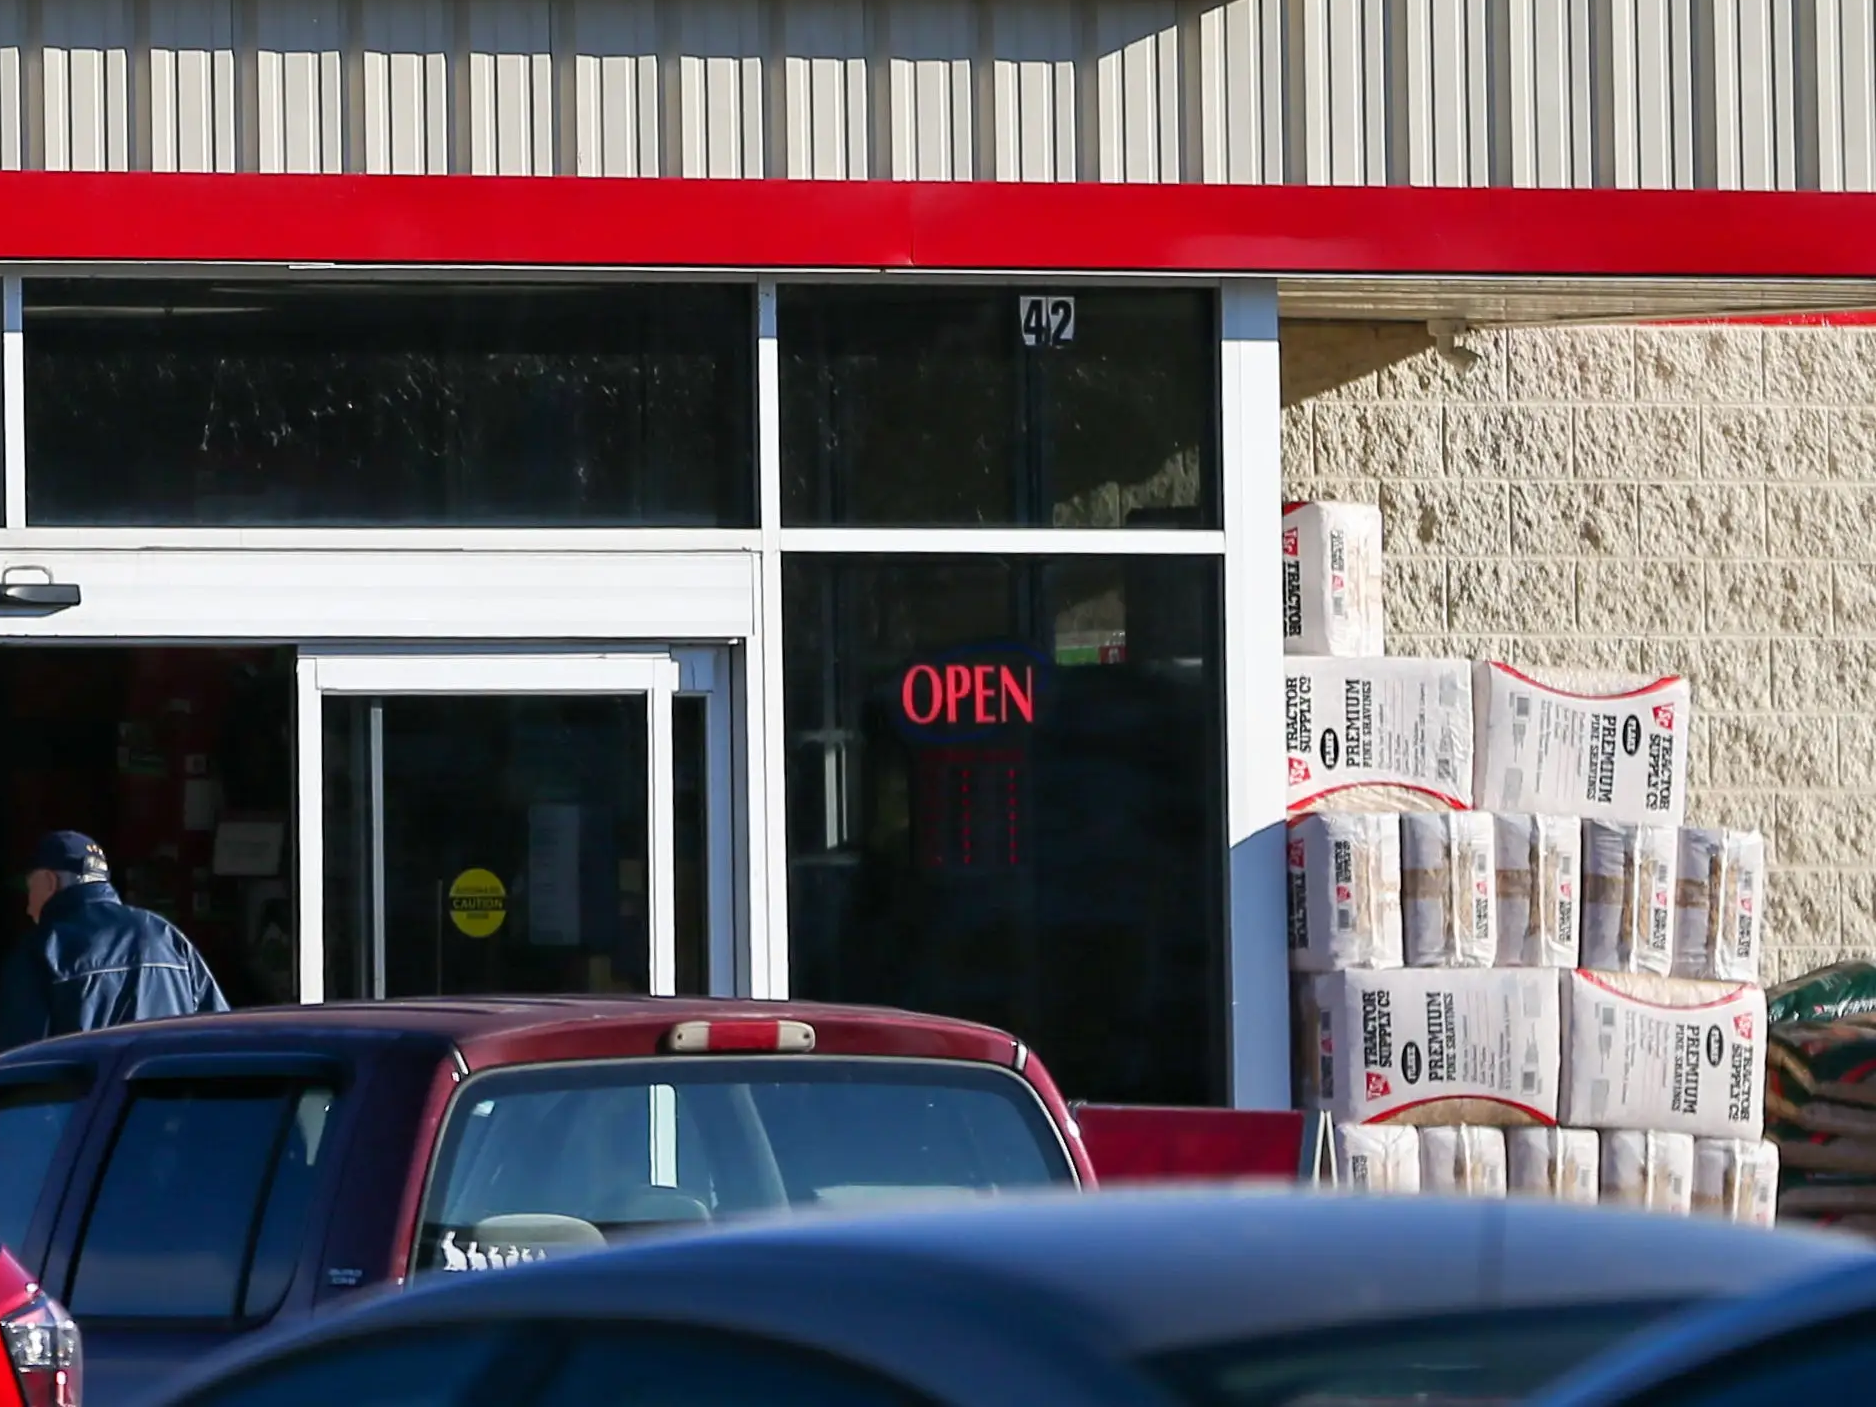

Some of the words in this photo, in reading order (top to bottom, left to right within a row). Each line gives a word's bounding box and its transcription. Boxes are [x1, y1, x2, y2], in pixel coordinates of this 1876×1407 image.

[1023, 298, 1073, 344] 42
[1287, 560, 1302, 637] TRACTOR
[902, 664, 1034, 724] OPEN
[1286, 676, 1298, 753] TRACTOR
[1362, 680, 1373, 736] SHAVINGS
[1299, 696, 1312, 753] SUPPLY
[1345, 678, 1361, 768] PREMIUM
[1591, 713, 1600, 742] PINE
[1363, 737, 1373, 768] PINE
[1587, 745, 1599, 800] SHAVINGS
[1598, 714, 1617, 804] PREMIUM
[1647, 734, 1661, 790] SUPPLY
[1659, 735, 1673, 811] TRACTOR
[453, 897, 503, 910] CAUTION
[1363, 990, 1377, 1067] TRACTOR
[1378, 1010, 1392, 1067] SUPPLY
[1426, 991, 1444, 1082] PREMIUM
[1444, 992, 1456, 1049] SHAVINGS
[1675, 1024, 1685, 1053] PINE
[1446, 1053, 1456, 1081] PINE
[1671, 1056, 1683, 1112] SHAVINGS
[1683, 1024, 1700, 1114] PREMIUM
[1729, 1044, 1742, 1100] SUPPLY
[1740, 1045, 1753, 1121] TRACTOR
